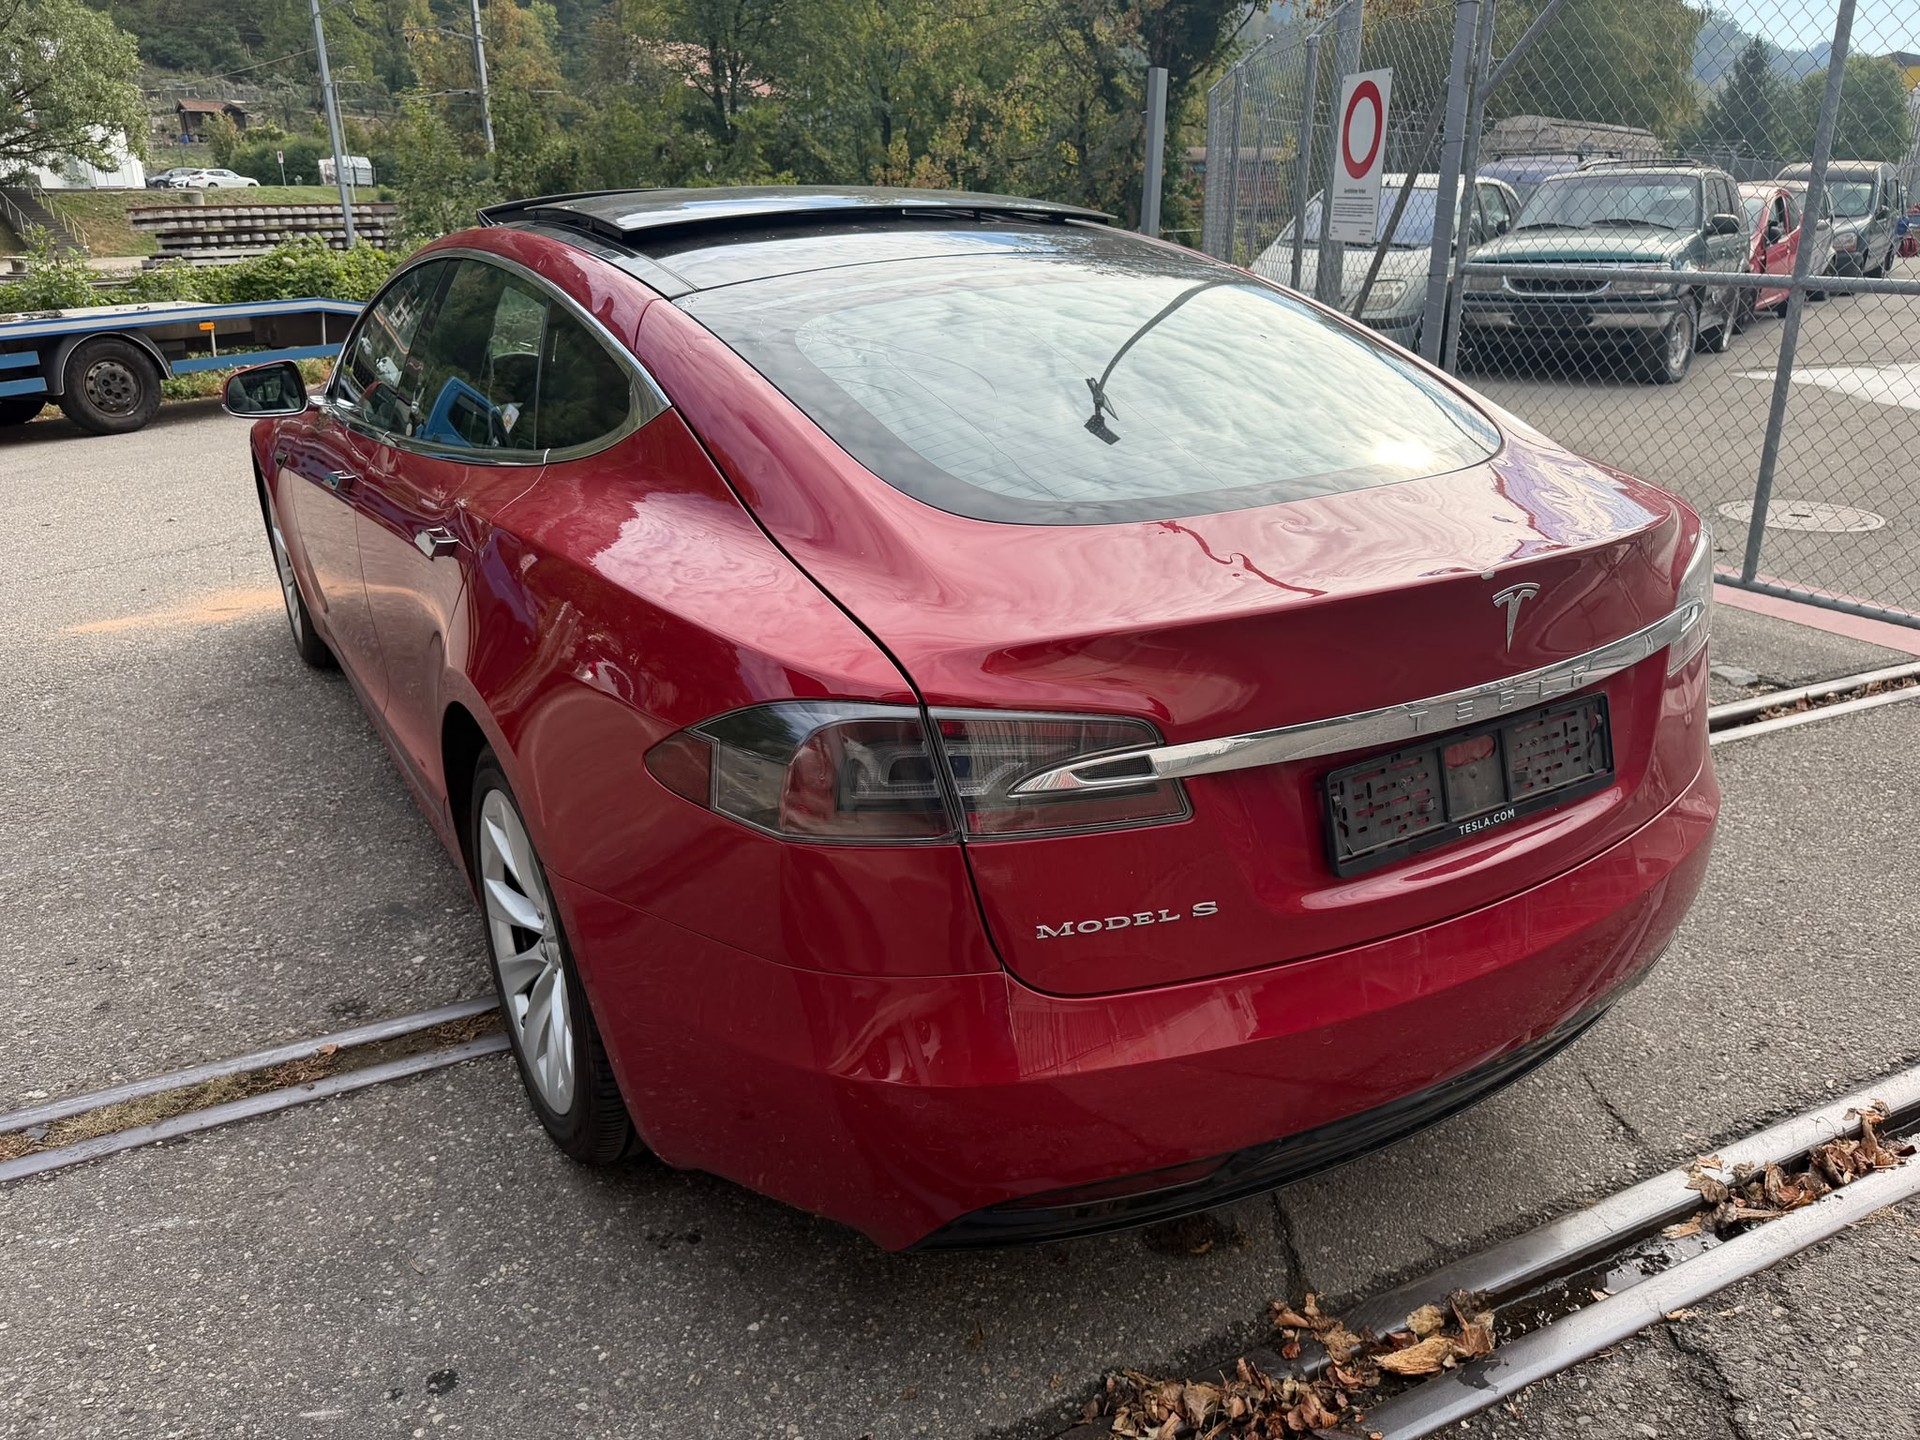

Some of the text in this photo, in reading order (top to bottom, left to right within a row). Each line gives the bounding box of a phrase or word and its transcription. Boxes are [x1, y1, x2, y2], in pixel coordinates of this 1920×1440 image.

[1409, 665, 1586, 732] TESLA
[1458, 808, 1515, 836] TESLA.COM
[1036, 901, 1219, 939] MODEL S
